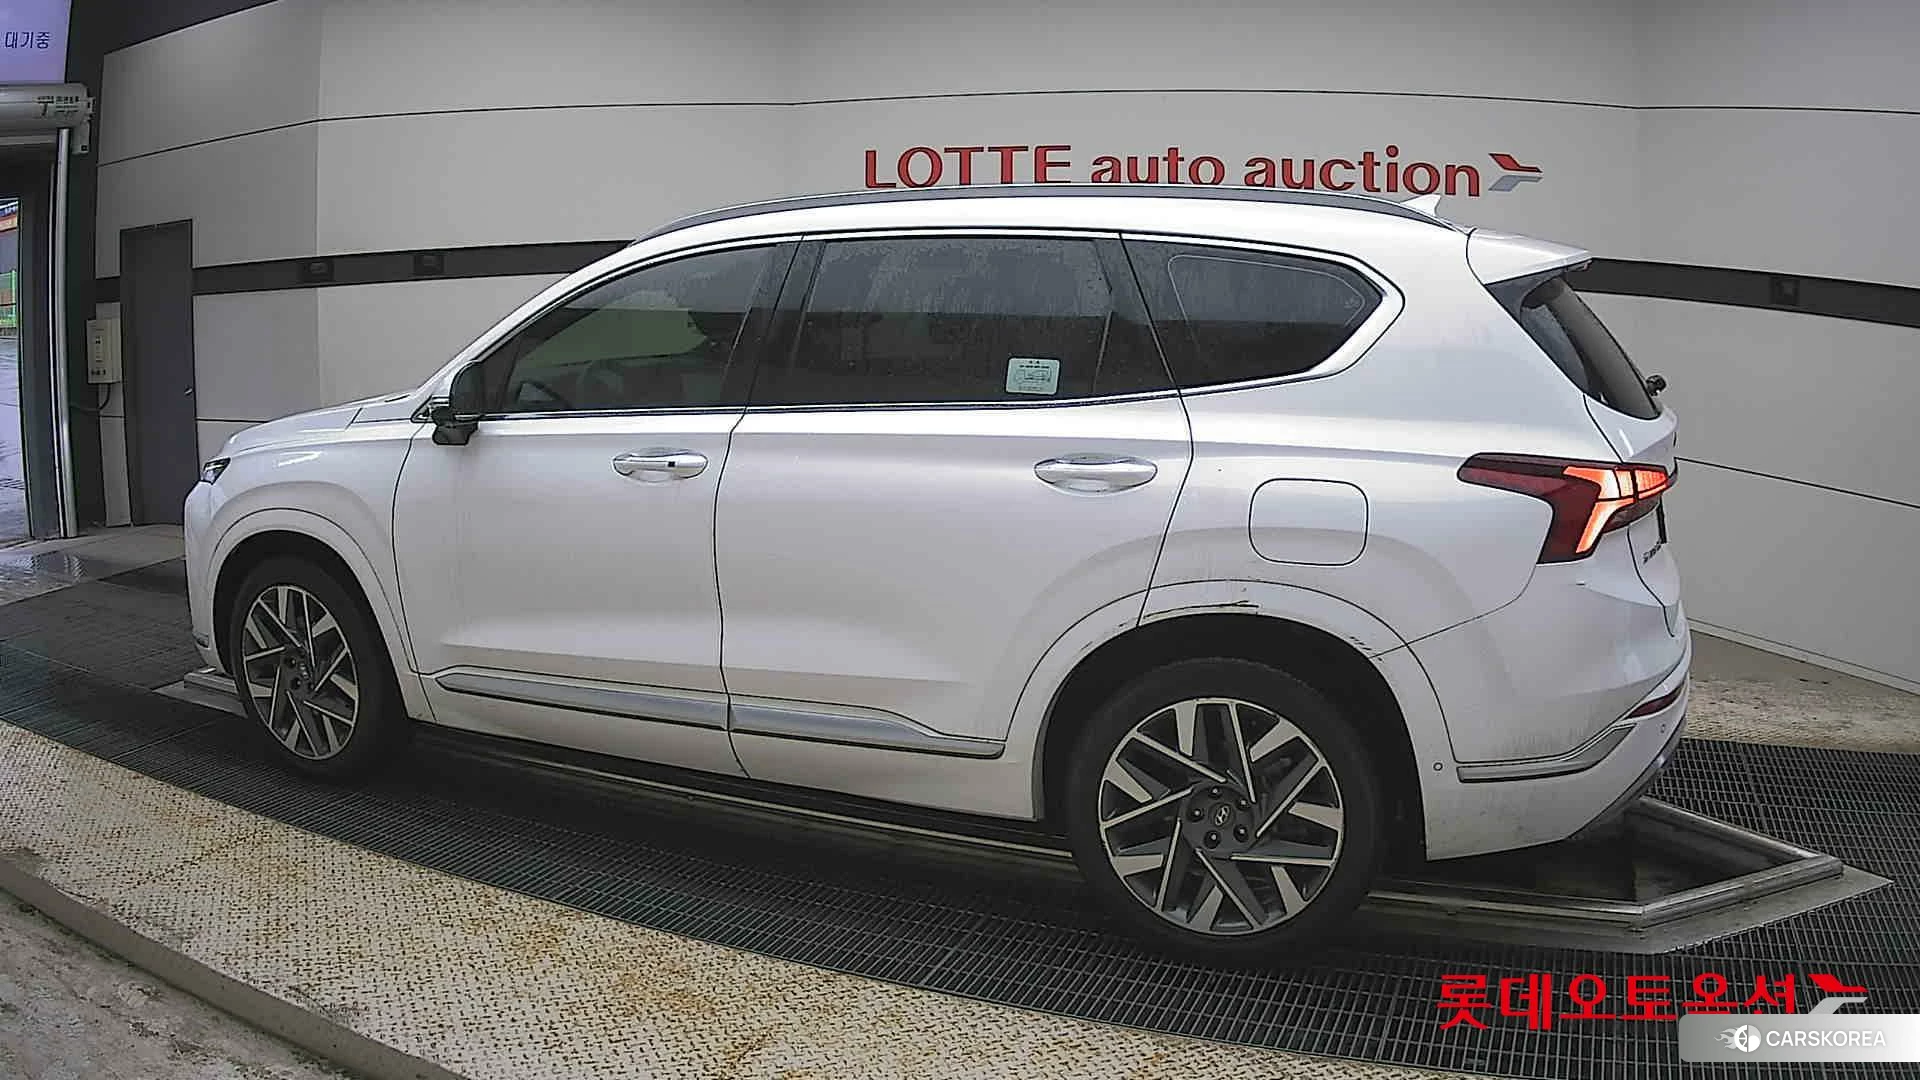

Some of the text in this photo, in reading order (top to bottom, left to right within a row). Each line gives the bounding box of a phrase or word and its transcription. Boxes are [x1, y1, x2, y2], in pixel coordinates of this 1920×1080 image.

[5, 31, 50, 49] 대기중
[864, 145, 1480, 197] LOTTE auto auction
